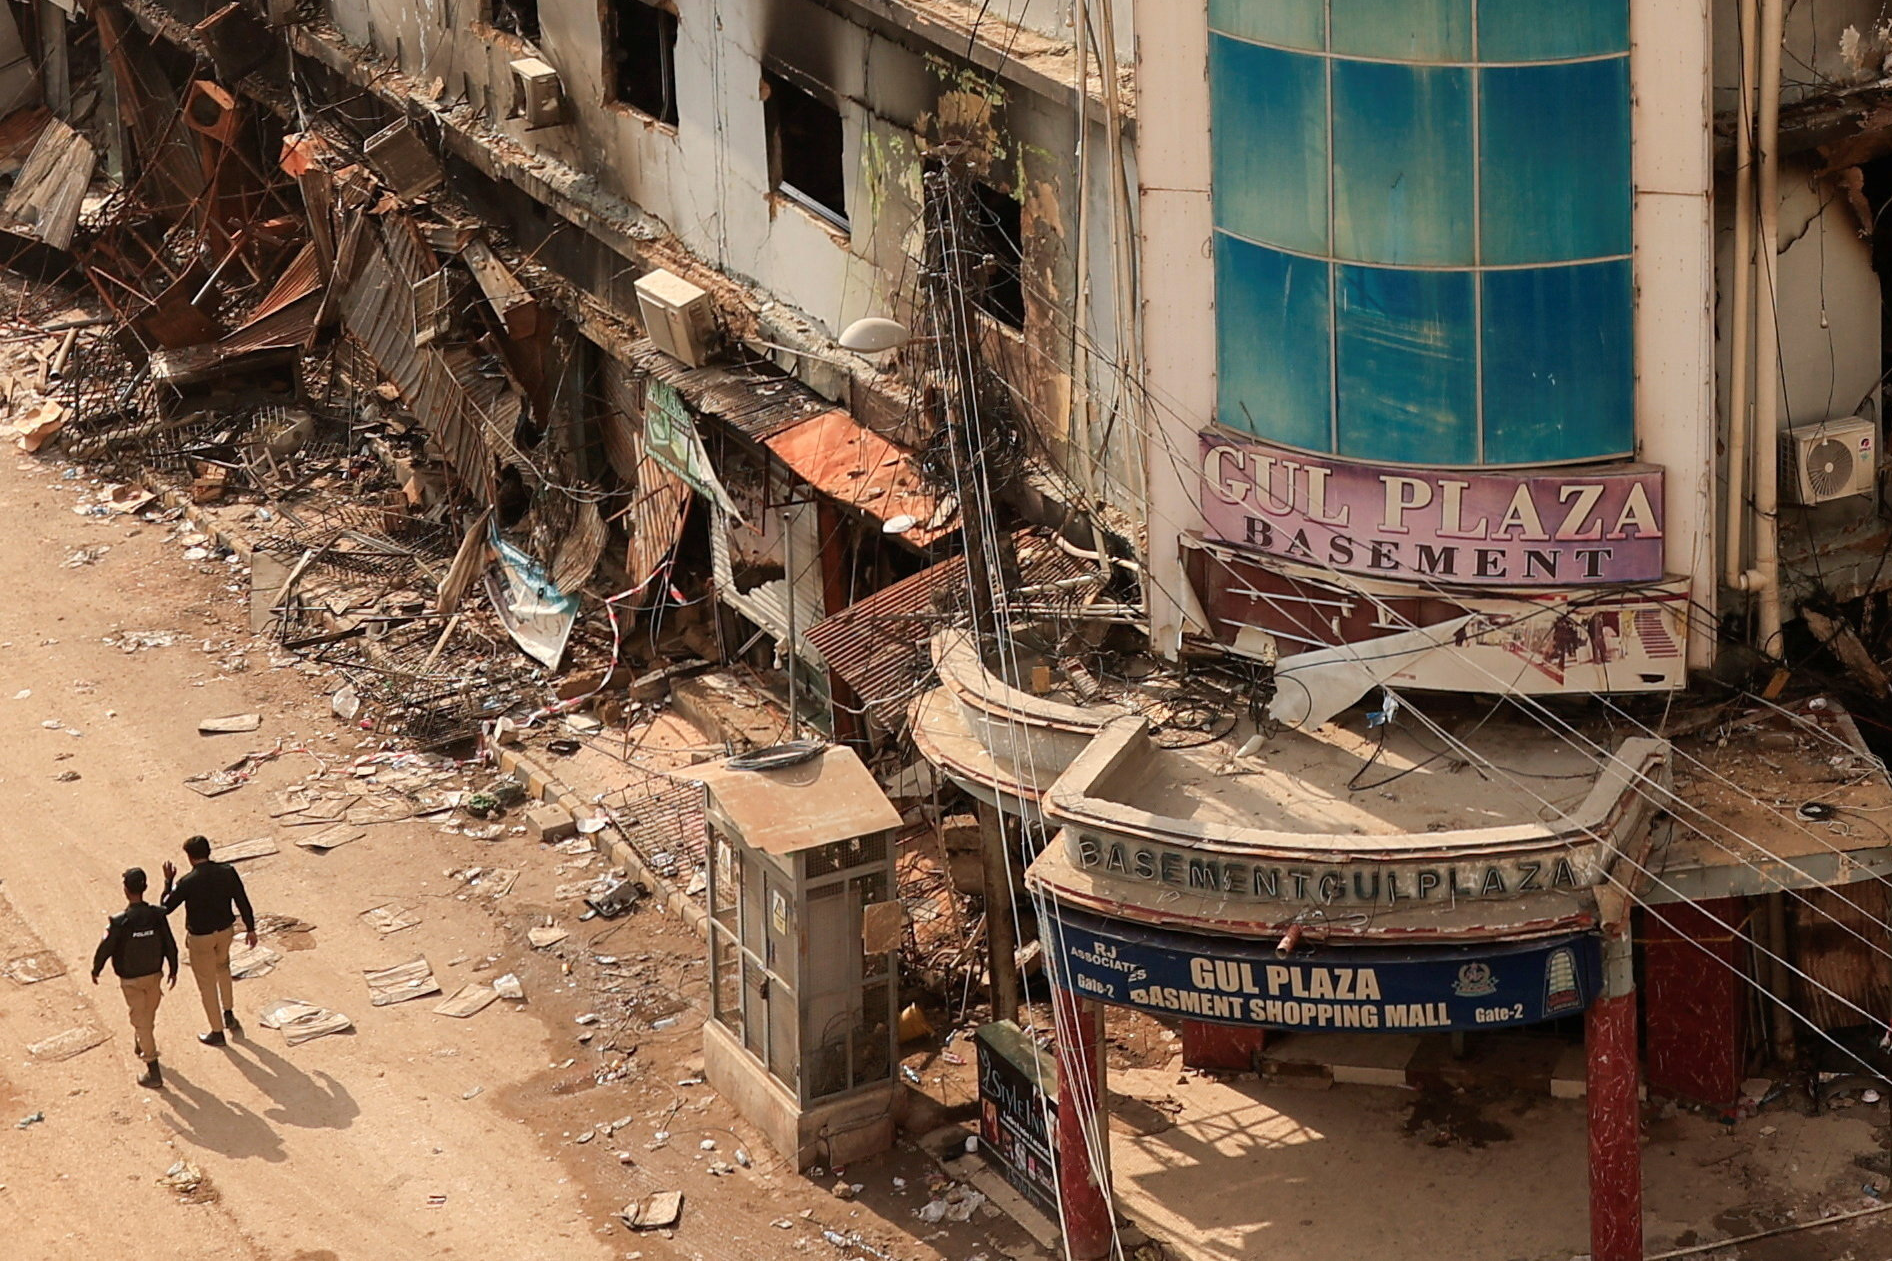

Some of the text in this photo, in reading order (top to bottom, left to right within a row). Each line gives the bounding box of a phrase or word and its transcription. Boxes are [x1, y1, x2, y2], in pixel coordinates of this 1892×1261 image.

[1203, 445, 1662, 543] GUL PLAZA
[1243, 516, 1613, 579] BASEMENT
[1093, 942, 1117, 959] RJ
[1077, 973, 1115, 999] Gate-2
[1189, 957, 1382, 1001] GUL PLAZA
[1250, 999, 1379, 1028] SHOPPING
[1385, 1003, 1451, 1028] MALL
[1475, 1003, 1524, 1024] Gate-2
